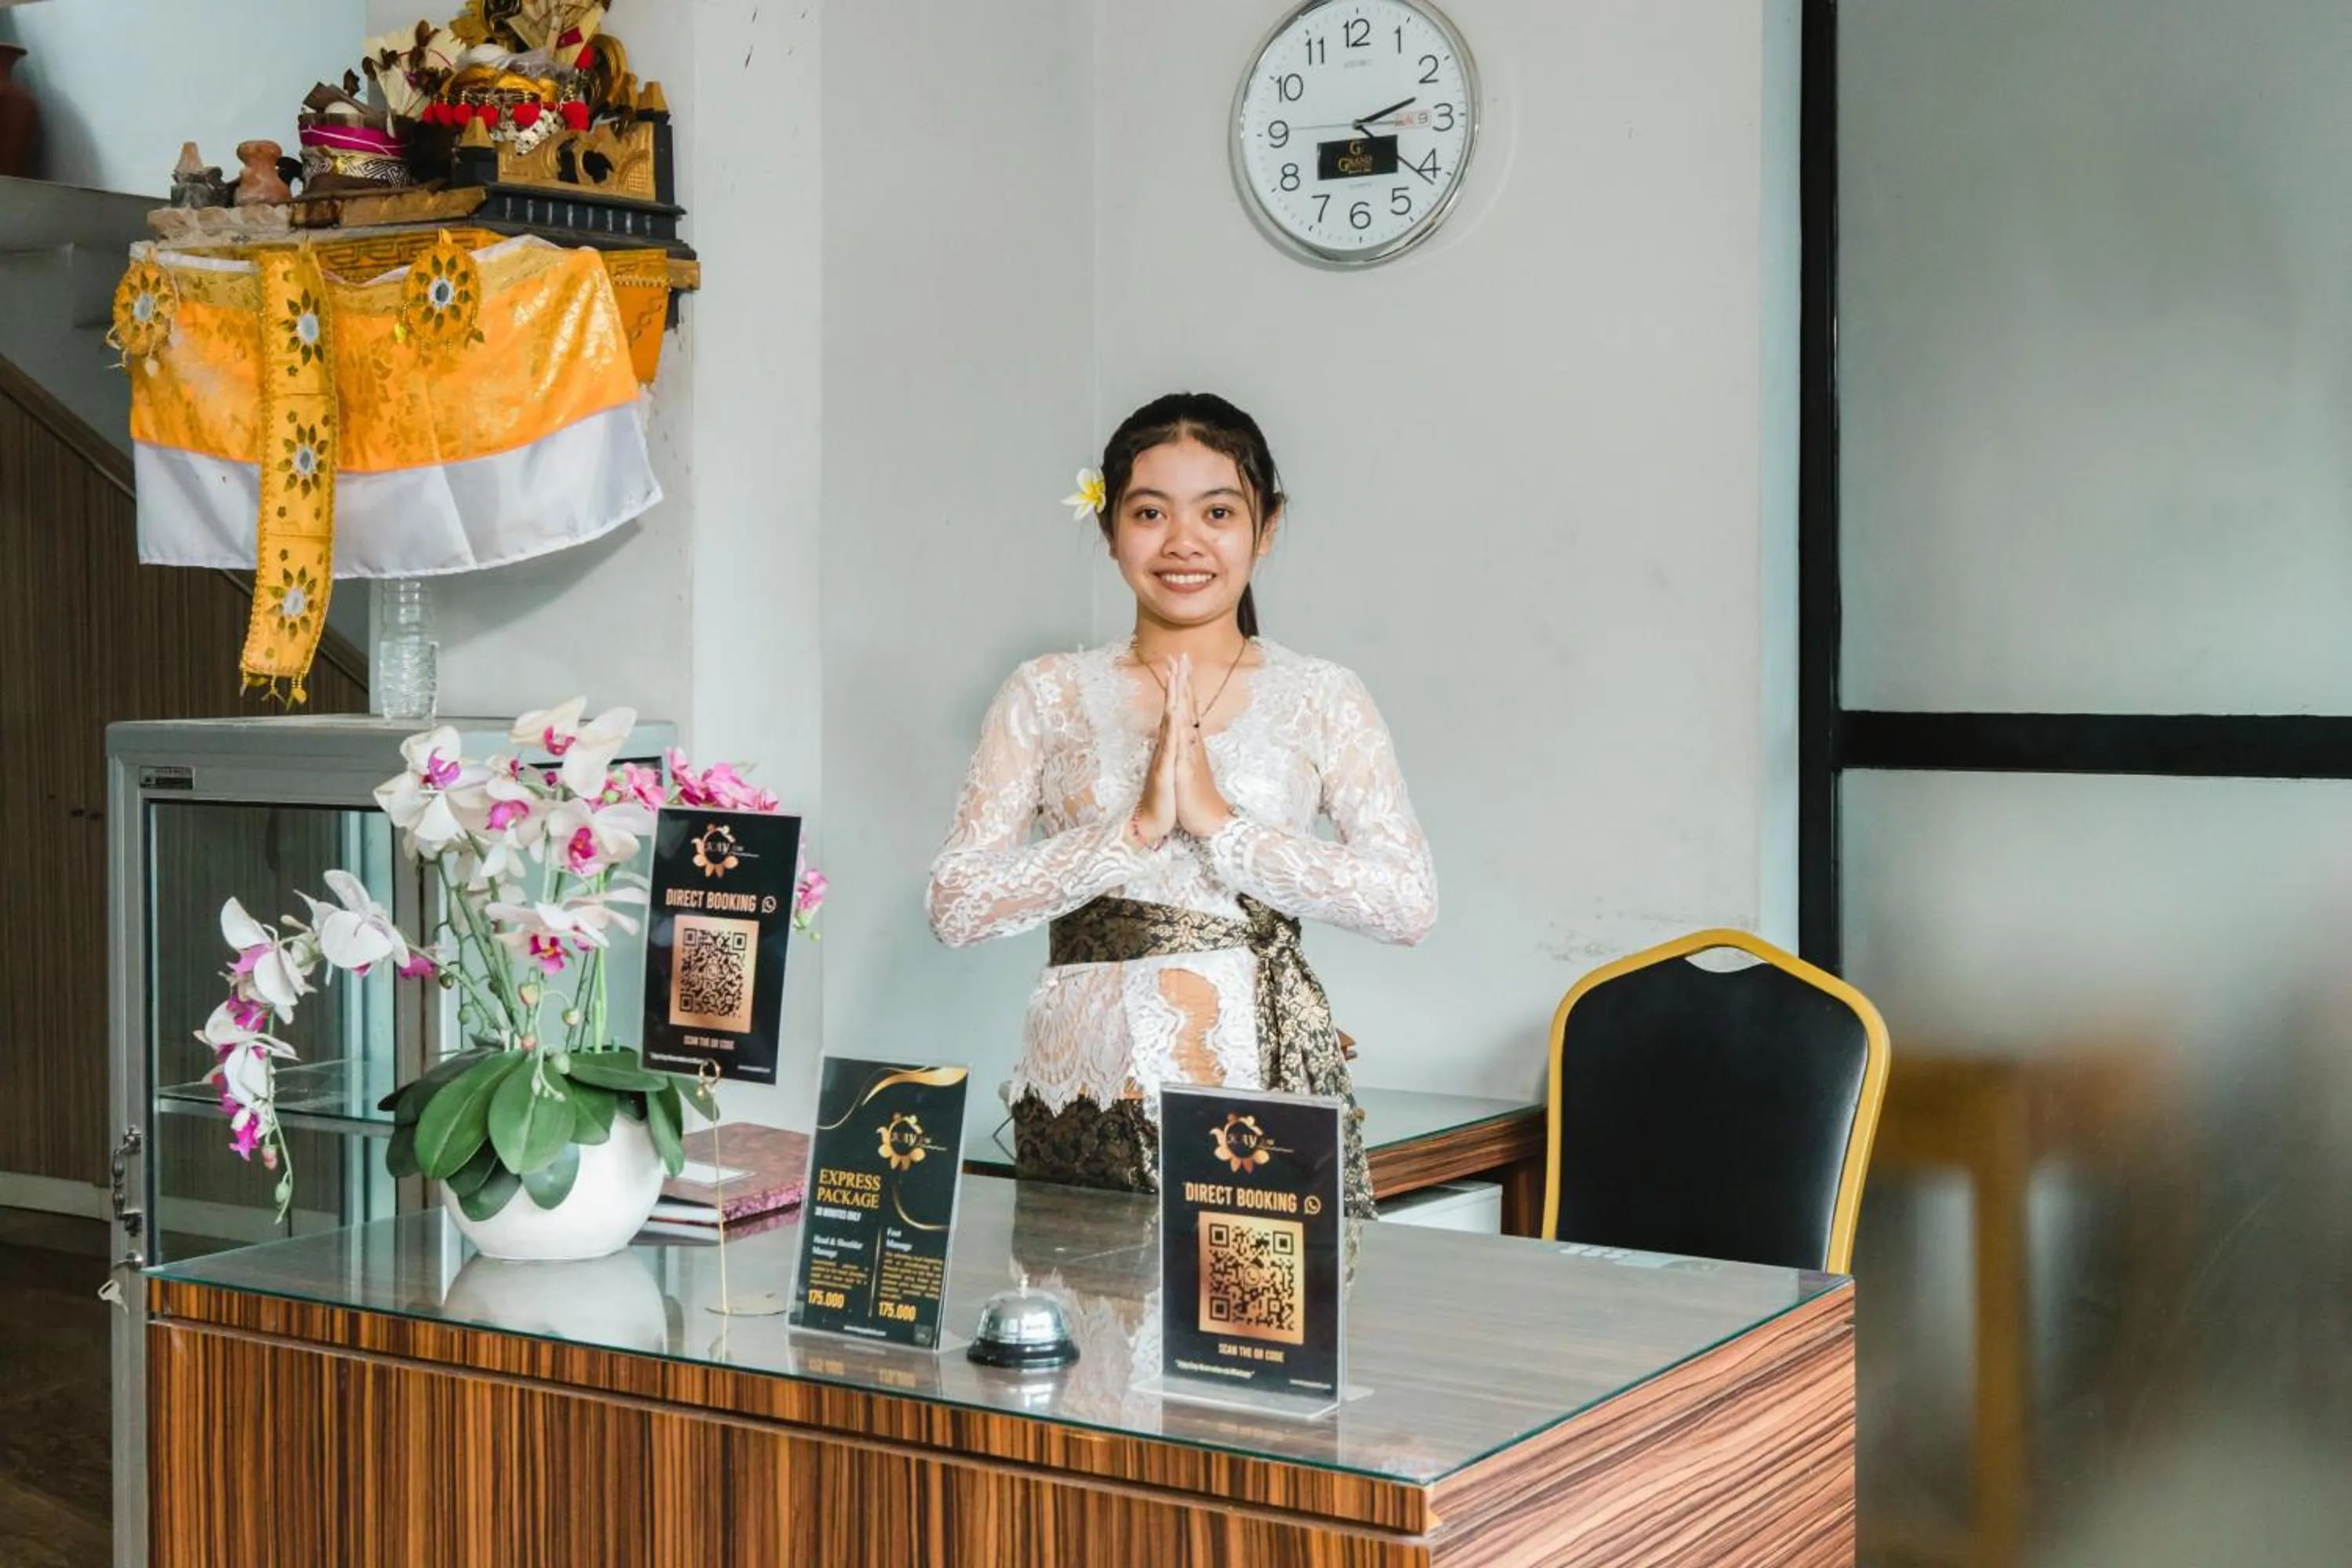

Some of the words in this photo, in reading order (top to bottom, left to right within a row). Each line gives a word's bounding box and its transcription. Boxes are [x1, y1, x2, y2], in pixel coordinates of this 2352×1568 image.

[1342, 18, 1371, 48] 12
[1394, 25, 1402, 54] 1
[1305, 36, 1326, 66] 11
[1417, 54, 1439, 85] 2
[1276, 73, 1305, 103] 10
[1432, 102, 1455, 132] 3
[1267, 119, 1290, 149] 9
[1279, 162, 1301, 192] 8
[1416, 147, 1442, 180] 4
[1311, 194, 1331, 223] 7
[1348, 201, 1372, 230] 6
[1390, 186, 1413, 216] 5
[665, 887, 706, 909] DIRECT
[706, 890, 757, 913] BOOKING
[818, 1168, 881, 1191] EXPRESS
[817, 1186, 880, 1209] PACKAGE
[1185, 1181, 1233, 1206] DIRECT
[1236, 1187, 1298, 1214] BOOKING
[808, 1289, 844, 1308] 175.000
[878, 1301, 916, 1323] 175.000
